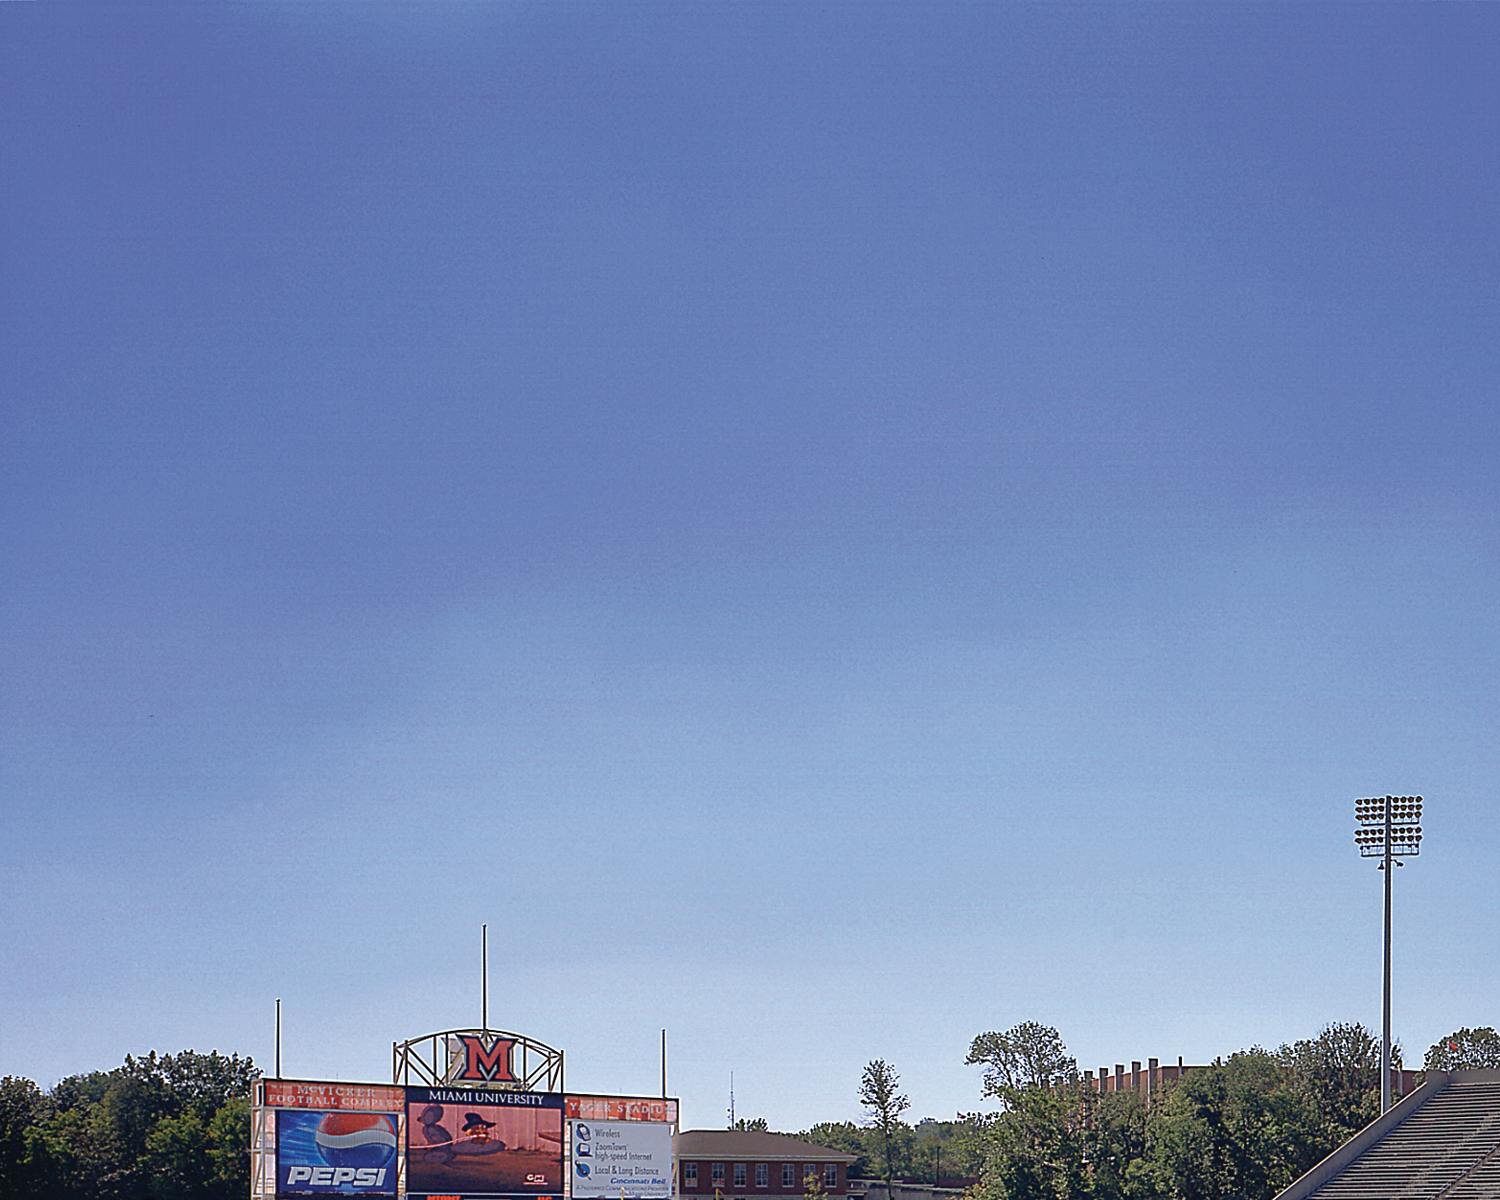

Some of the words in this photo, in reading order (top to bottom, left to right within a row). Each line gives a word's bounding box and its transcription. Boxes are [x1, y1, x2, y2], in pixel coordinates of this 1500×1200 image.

[268, 1094, 337, 1105] FOOTBALL
[429, 1090, 472, 1102] MIAMI
[475, 1092, 544, 1105] UNIVERSITY
[616, 1103, 676, 1114] STADIU
[594, 1128, 621, 1138] Wireless
[594, 1165, 611, 1174] Local
[618, 1166, 634, 1176] Long
[635, 1166, 659, 1175] Distance
[287, 1166, 386, 1187] PEPSI
